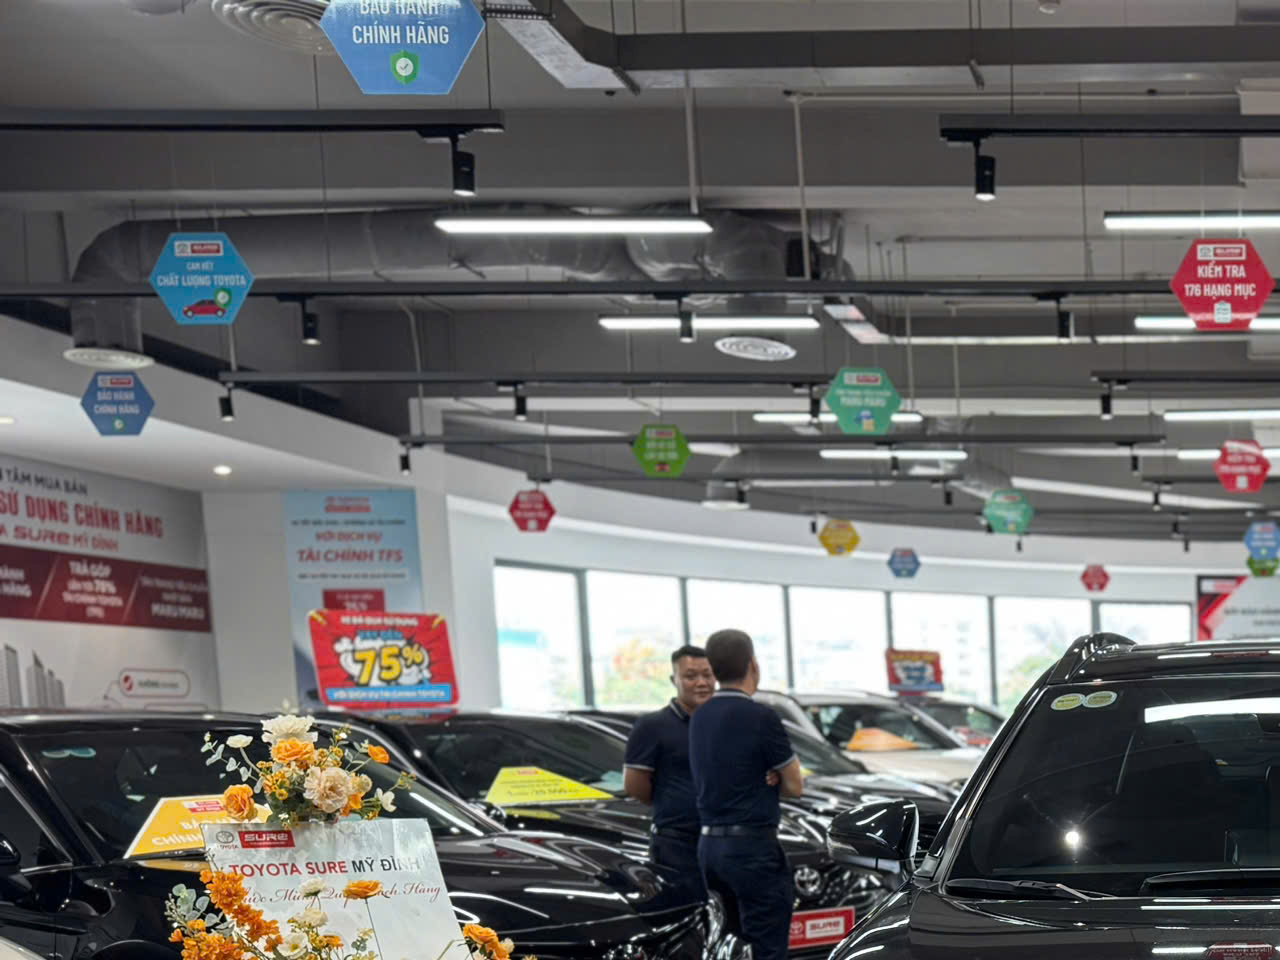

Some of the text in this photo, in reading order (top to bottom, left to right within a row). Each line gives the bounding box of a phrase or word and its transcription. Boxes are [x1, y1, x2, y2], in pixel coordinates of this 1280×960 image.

[352, 21, 449, 44] CHÍNH HÃNG
[157, 272, 179, 287] CHẤT
[213, 274, 247, 287] TOYOTA
[1197, 260, 1247, 278] KIỂM TRA
[1184, 284, 1257, 300] 176 HẠNG MỤC
[6, 467, 31, 486] TÂM
[33, 473, 61, 491] MUA
[25, 495, 70, 525] DỤNG
[74, 501, 121, 533] CHÍNH
[324, 547, 375, 562] CHÍNH
[354, 643, 425, 686] 75%
[229, 862, 302, 877] TOYOTA
[305, 861, 348, 875] SURE
[351, 856, 375, 873] MỸ
[403, 882, 441, 904] Hàng
